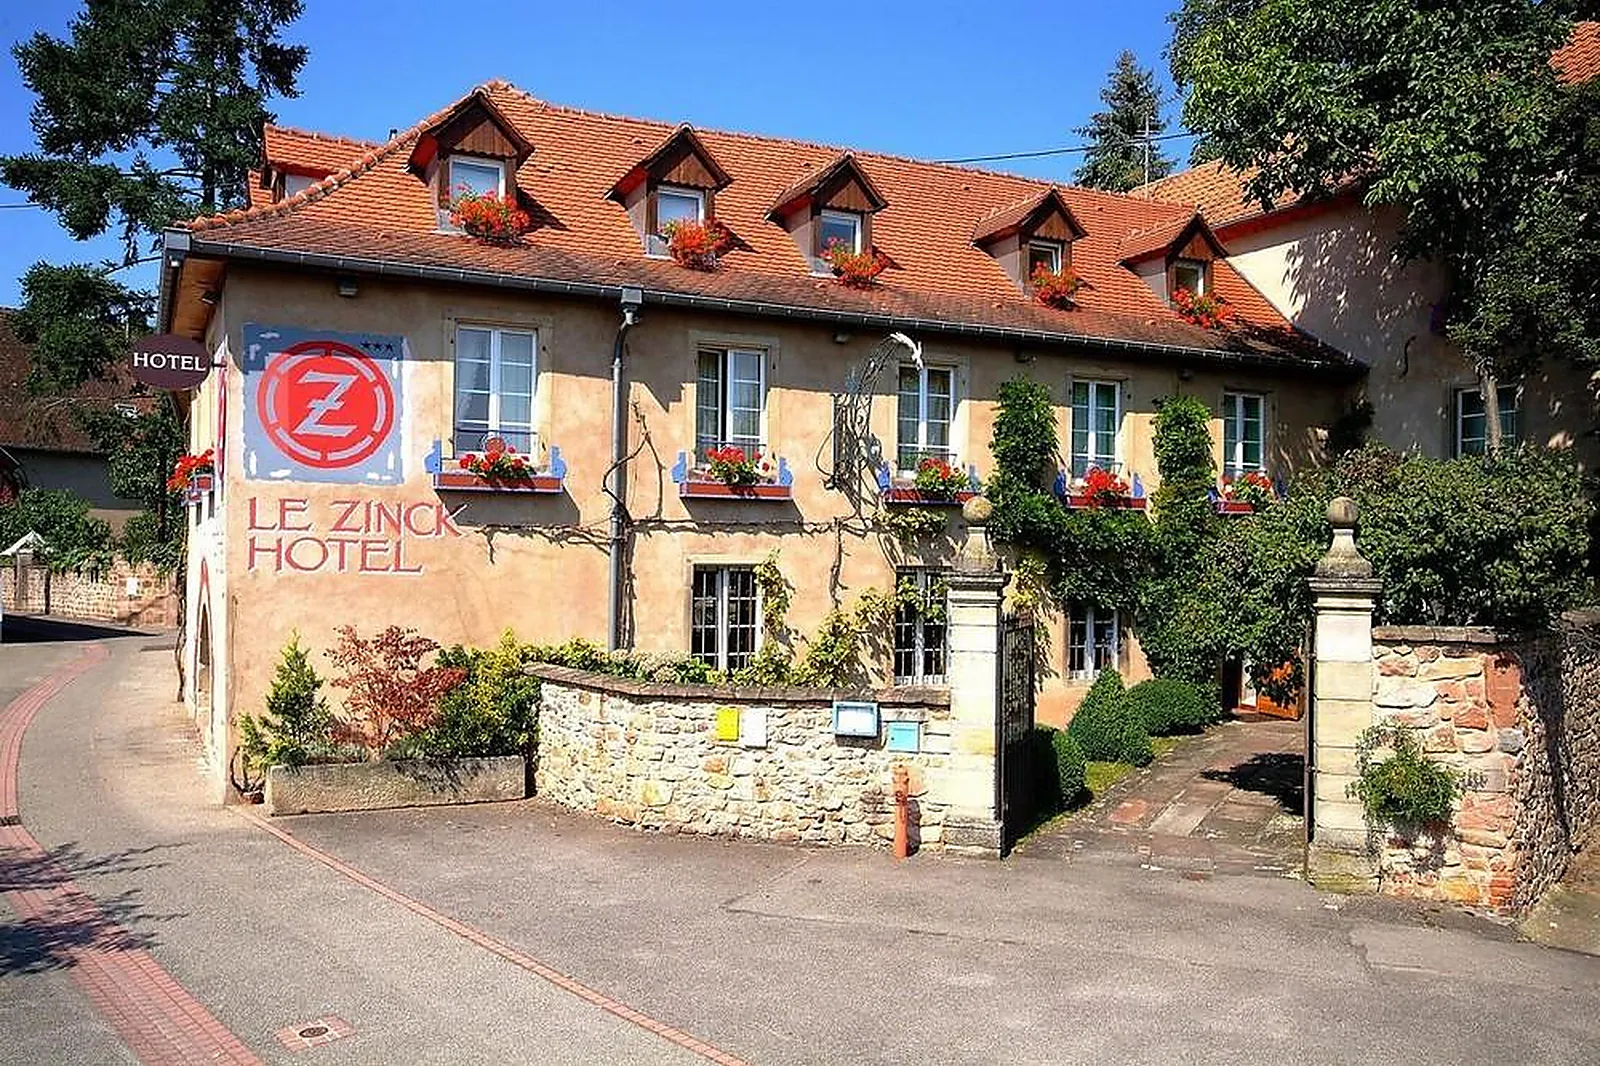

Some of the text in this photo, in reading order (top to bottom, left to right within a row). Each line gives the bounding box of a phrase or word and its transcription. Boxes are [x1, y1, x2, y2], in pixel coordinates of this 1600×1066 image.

[133, 352, 207, 372] HOTEL
[292, 370, 360, 438] Z
[247, 496, 468, 538] LE ZINCK
[247, 536, 423, 575] HOTEL
